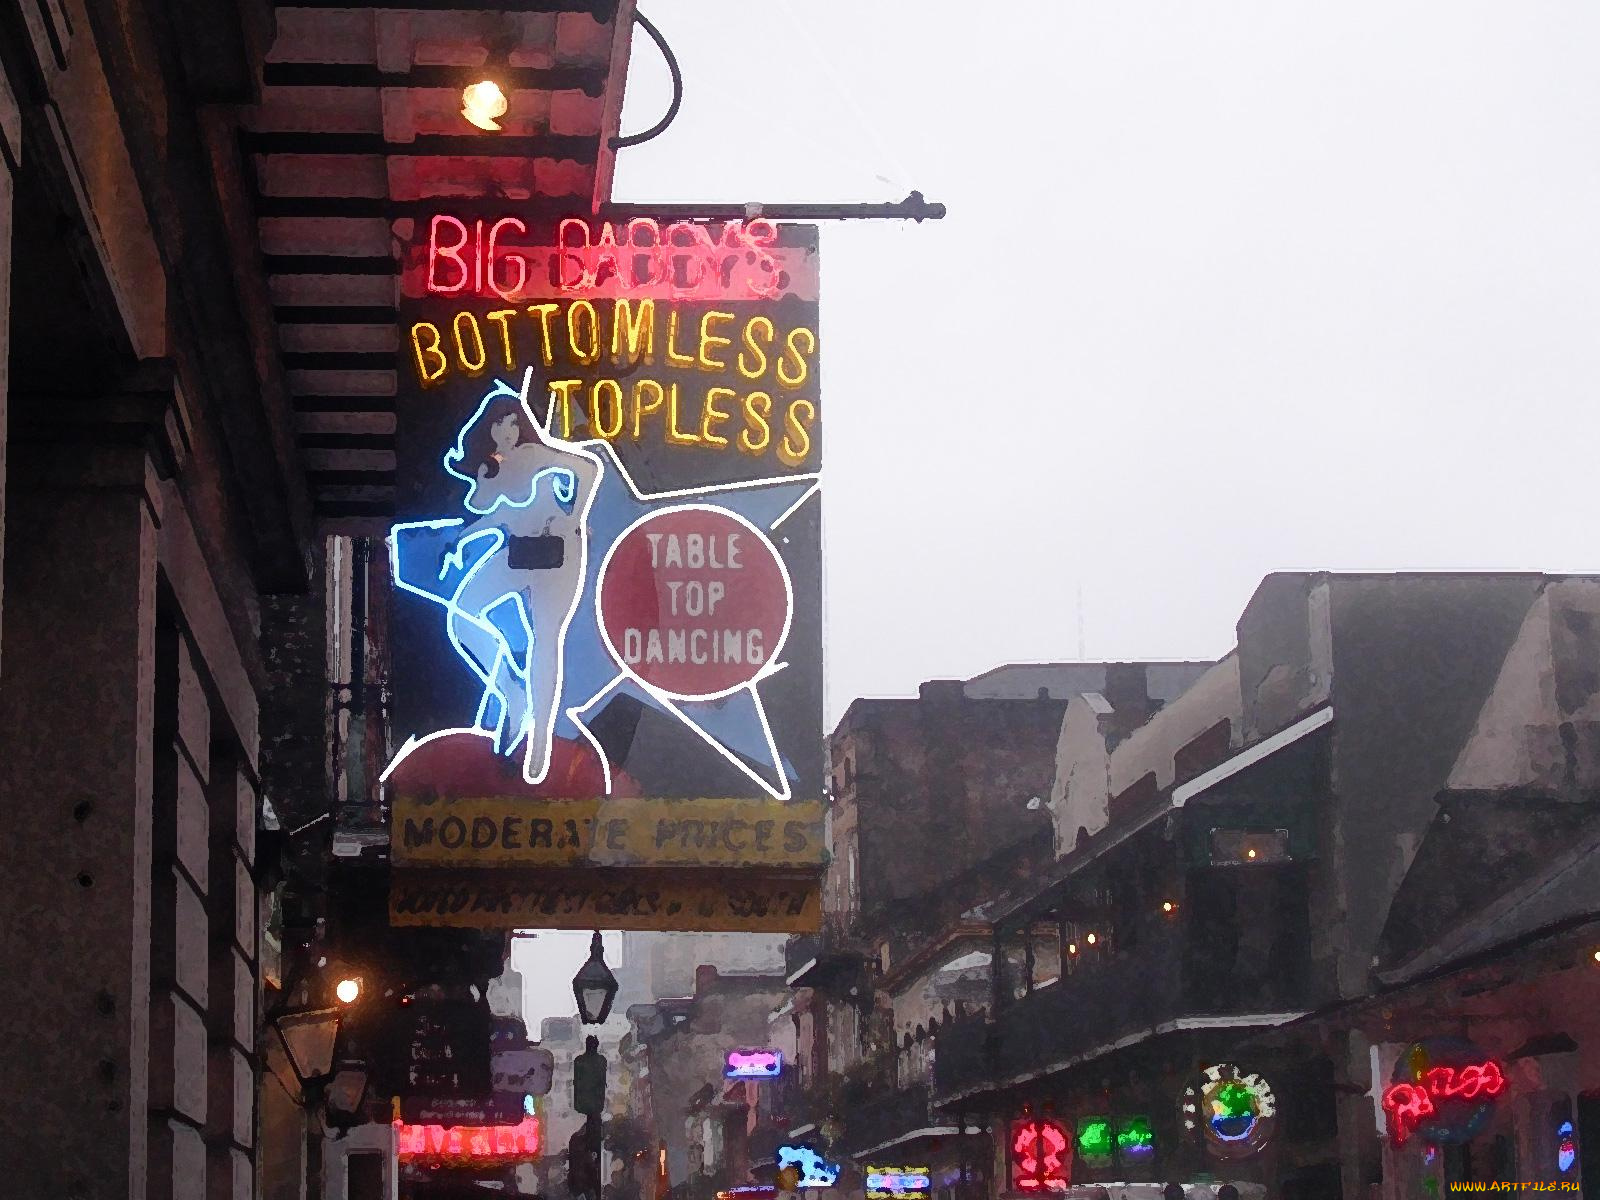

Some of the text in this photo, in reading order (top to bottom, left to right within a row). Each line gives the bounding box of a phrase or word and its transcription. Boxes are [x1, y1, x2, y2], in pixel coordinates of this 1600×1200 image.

[428, 214, 527, 300] BIG
[410, 299, 816, 388] BOTTOMLESS
[548, 379, 816, 466] TOPLESS
[646, 533, 744, 569] TABLE
[666, 580, 725, 616] TOP
[624, 627, 765, 665] DANCING
[655, 817, 809, 852] PRICES
